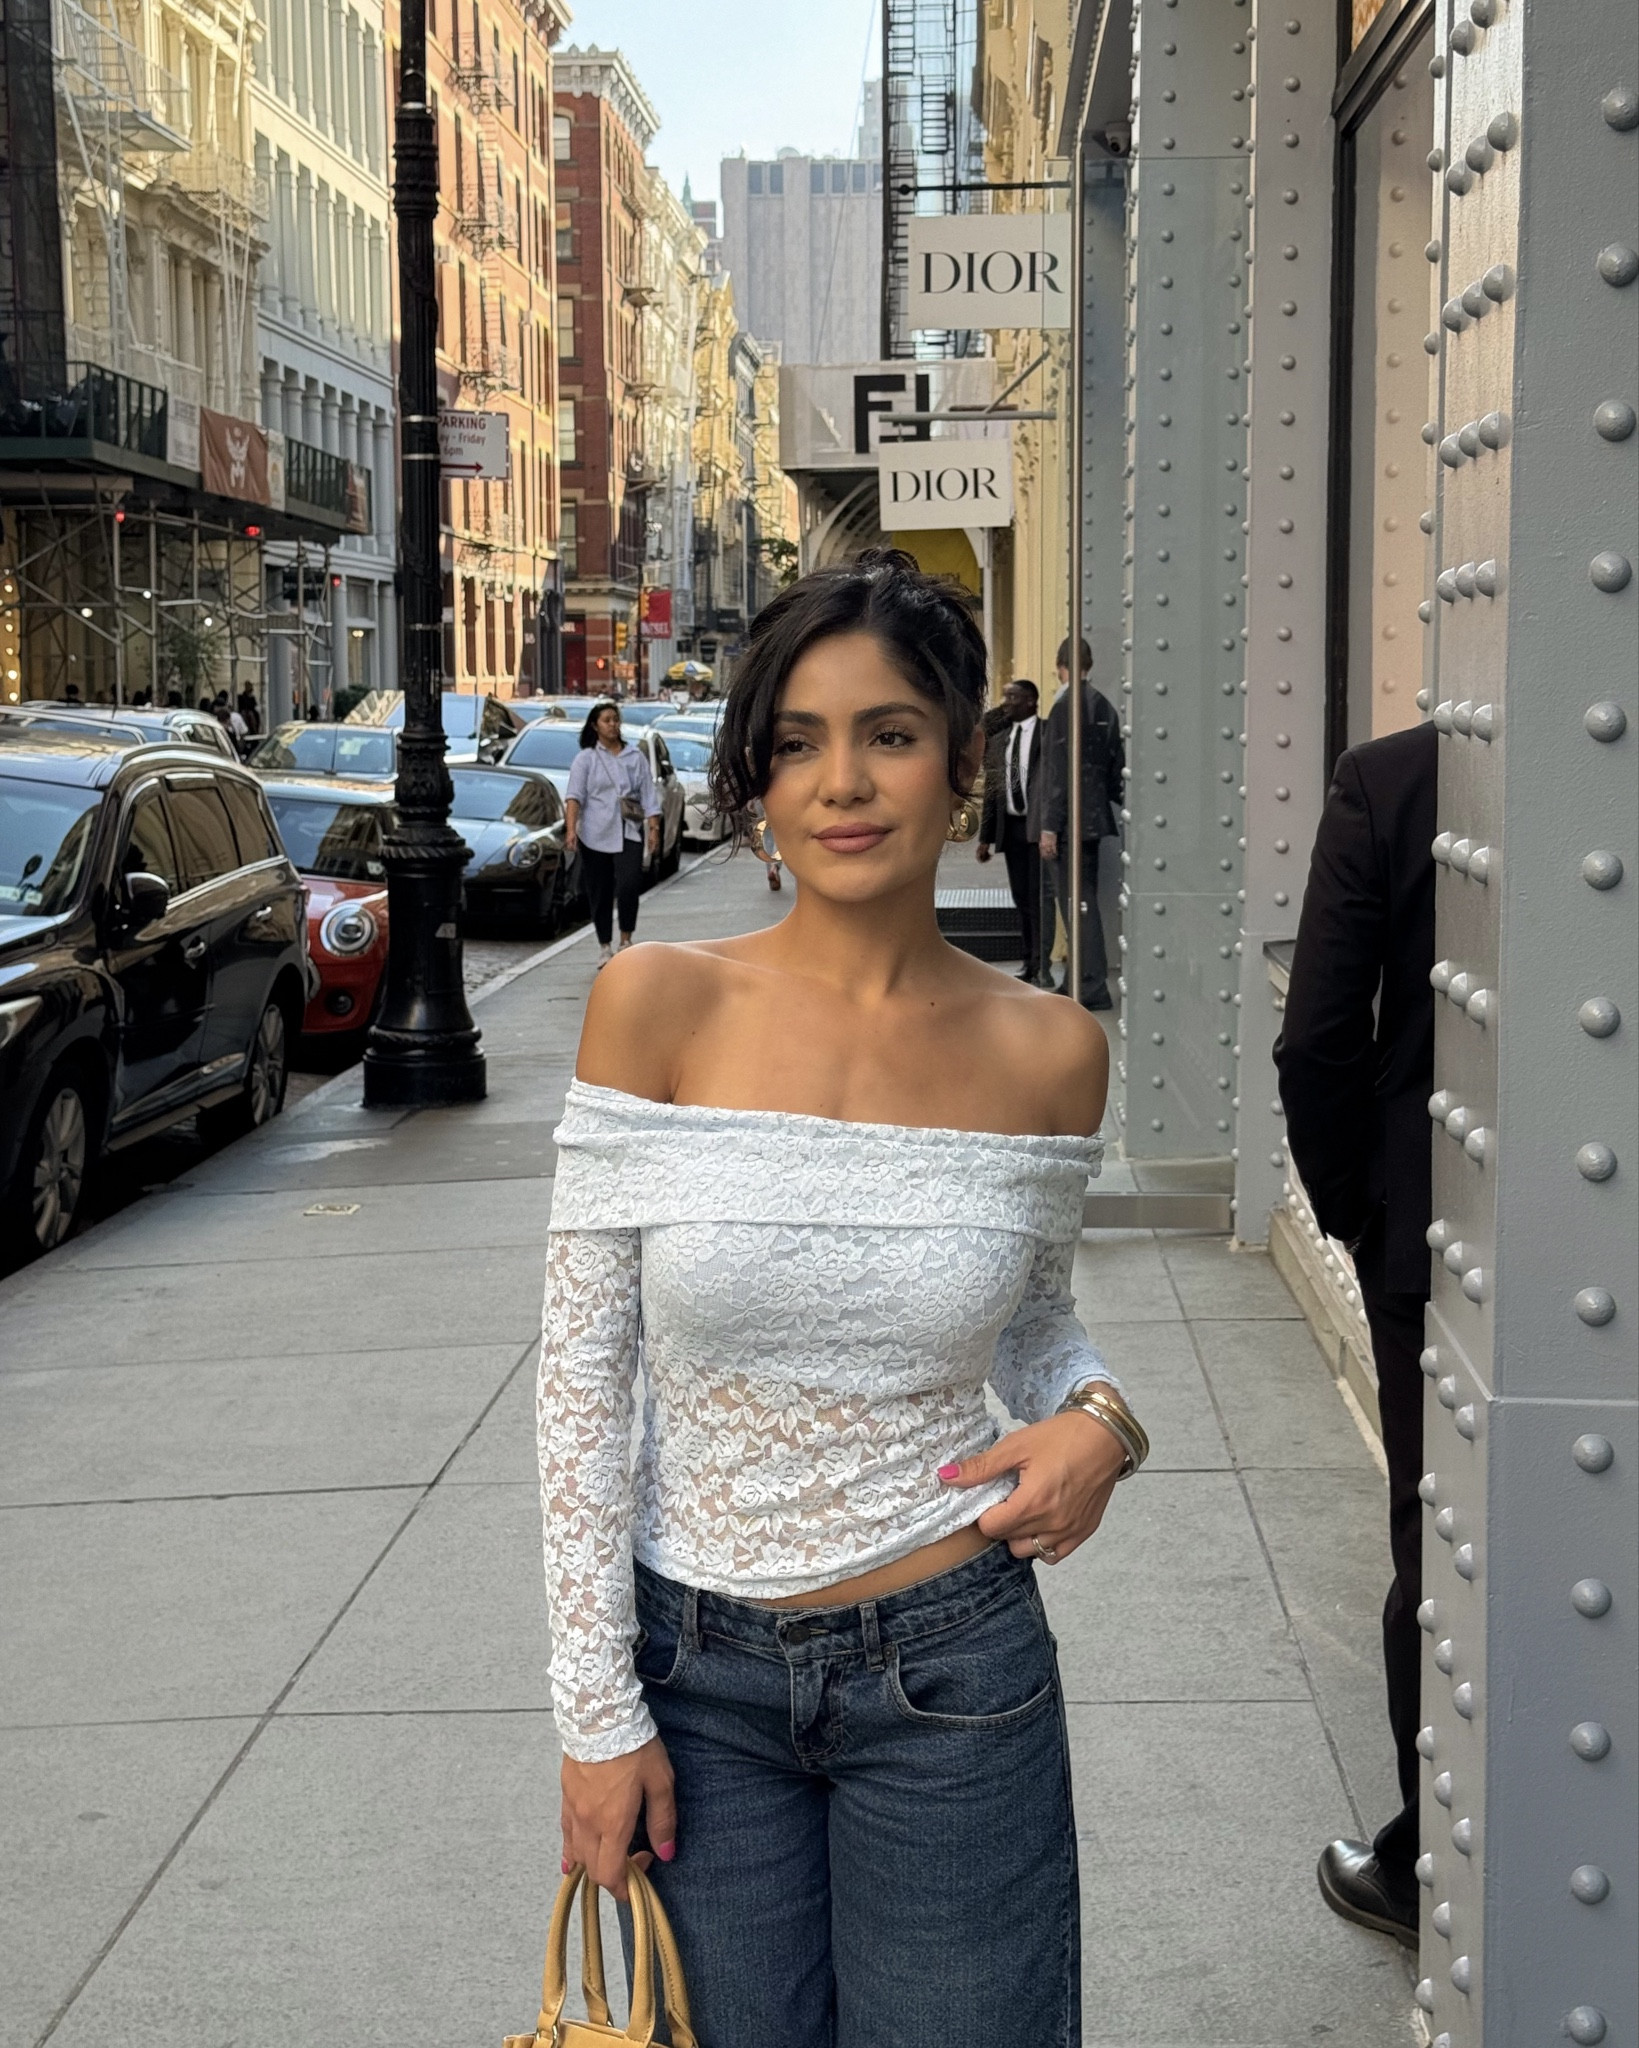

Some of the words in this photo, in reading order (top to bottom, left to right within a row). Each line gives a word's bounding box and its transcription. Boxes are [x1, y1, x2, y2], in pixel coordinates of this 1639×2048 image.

[919, 251, 1065, 294] DIOR
[459, 432, 486, 447] Friday
[890, 467, 1000, 503] DIOR
